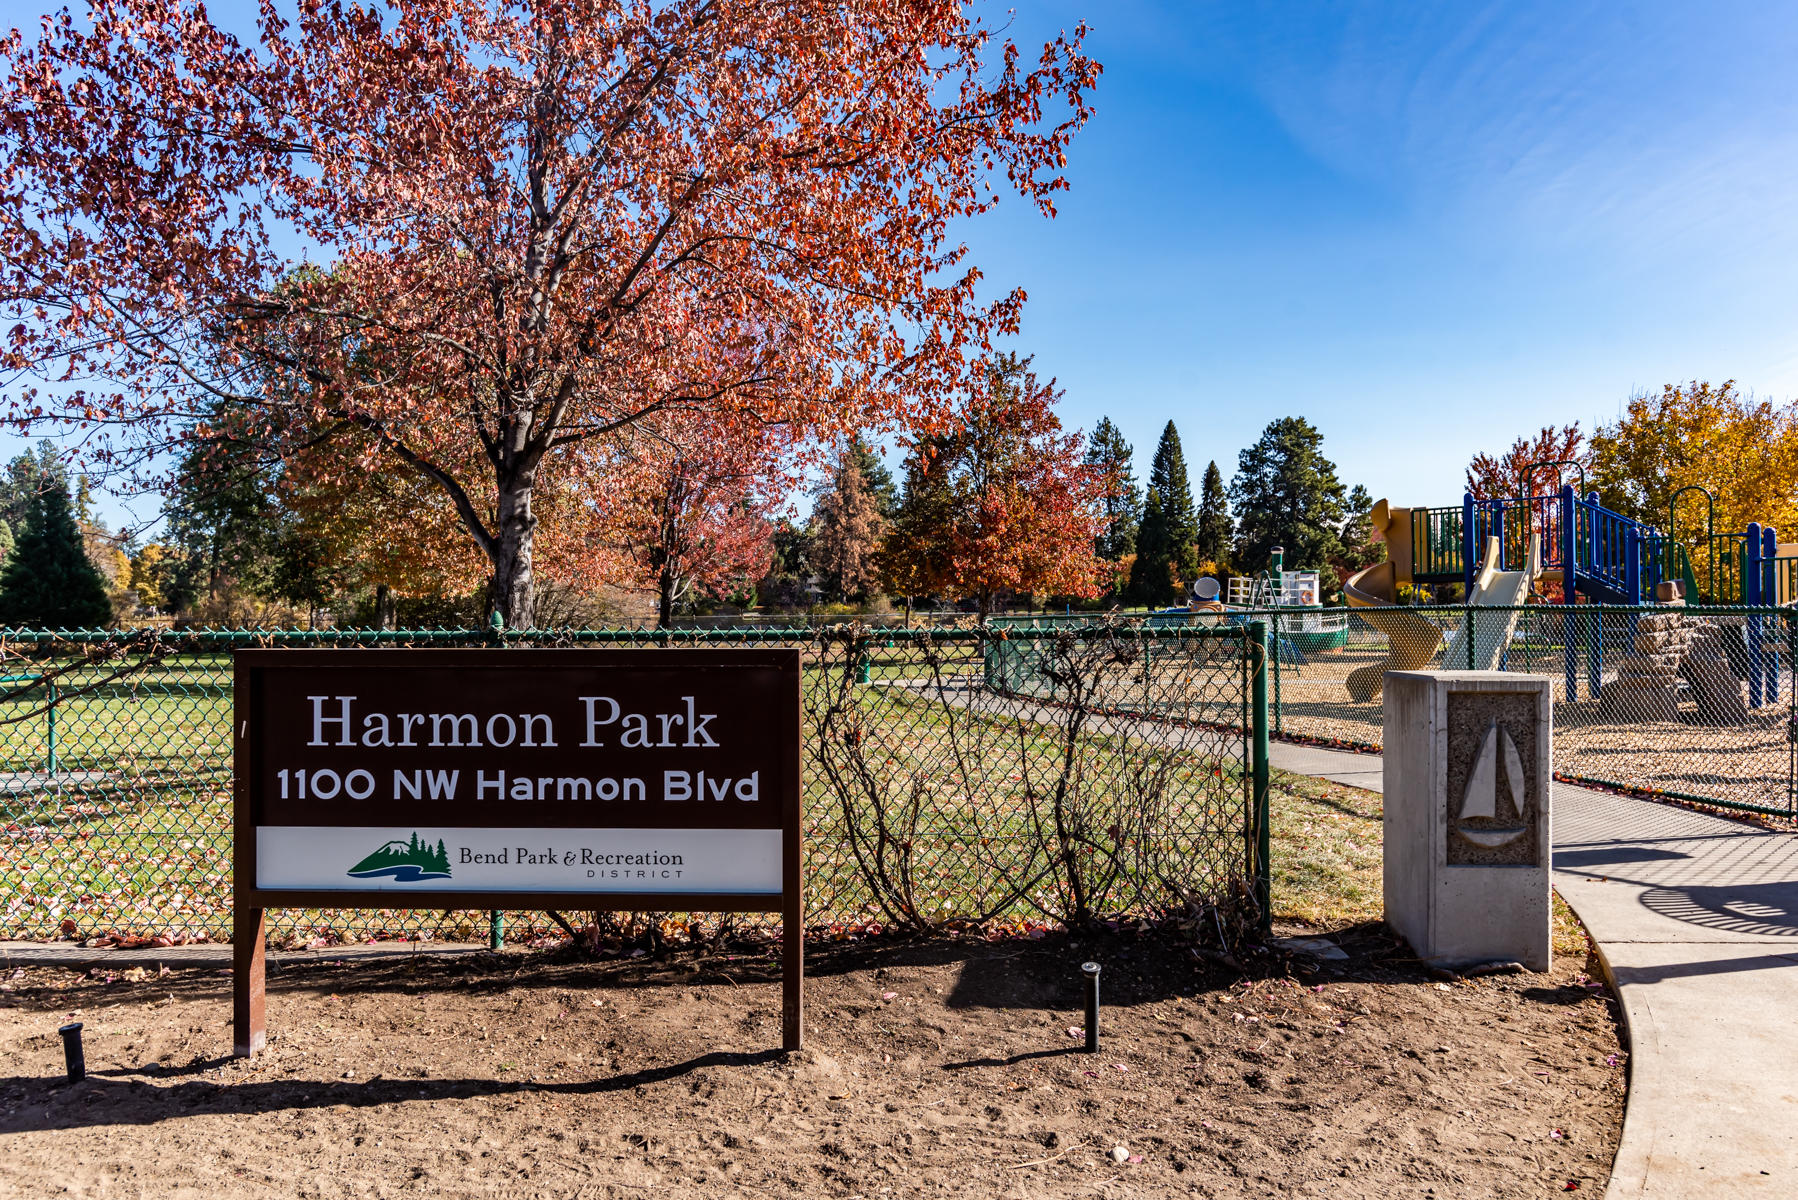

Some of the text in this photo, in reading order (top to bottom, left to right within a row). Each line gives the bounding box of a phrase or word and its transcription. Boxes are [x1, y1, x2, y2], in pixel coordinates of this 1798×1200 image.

[306, 695, 721, 748] Harmon Park
[277, 768, 759, 802] 1100 NW Harmon Blvd
[459, 847, 684, 867] Bend Park & Recreation
[587, 869, 683, 879] DISTRICT
